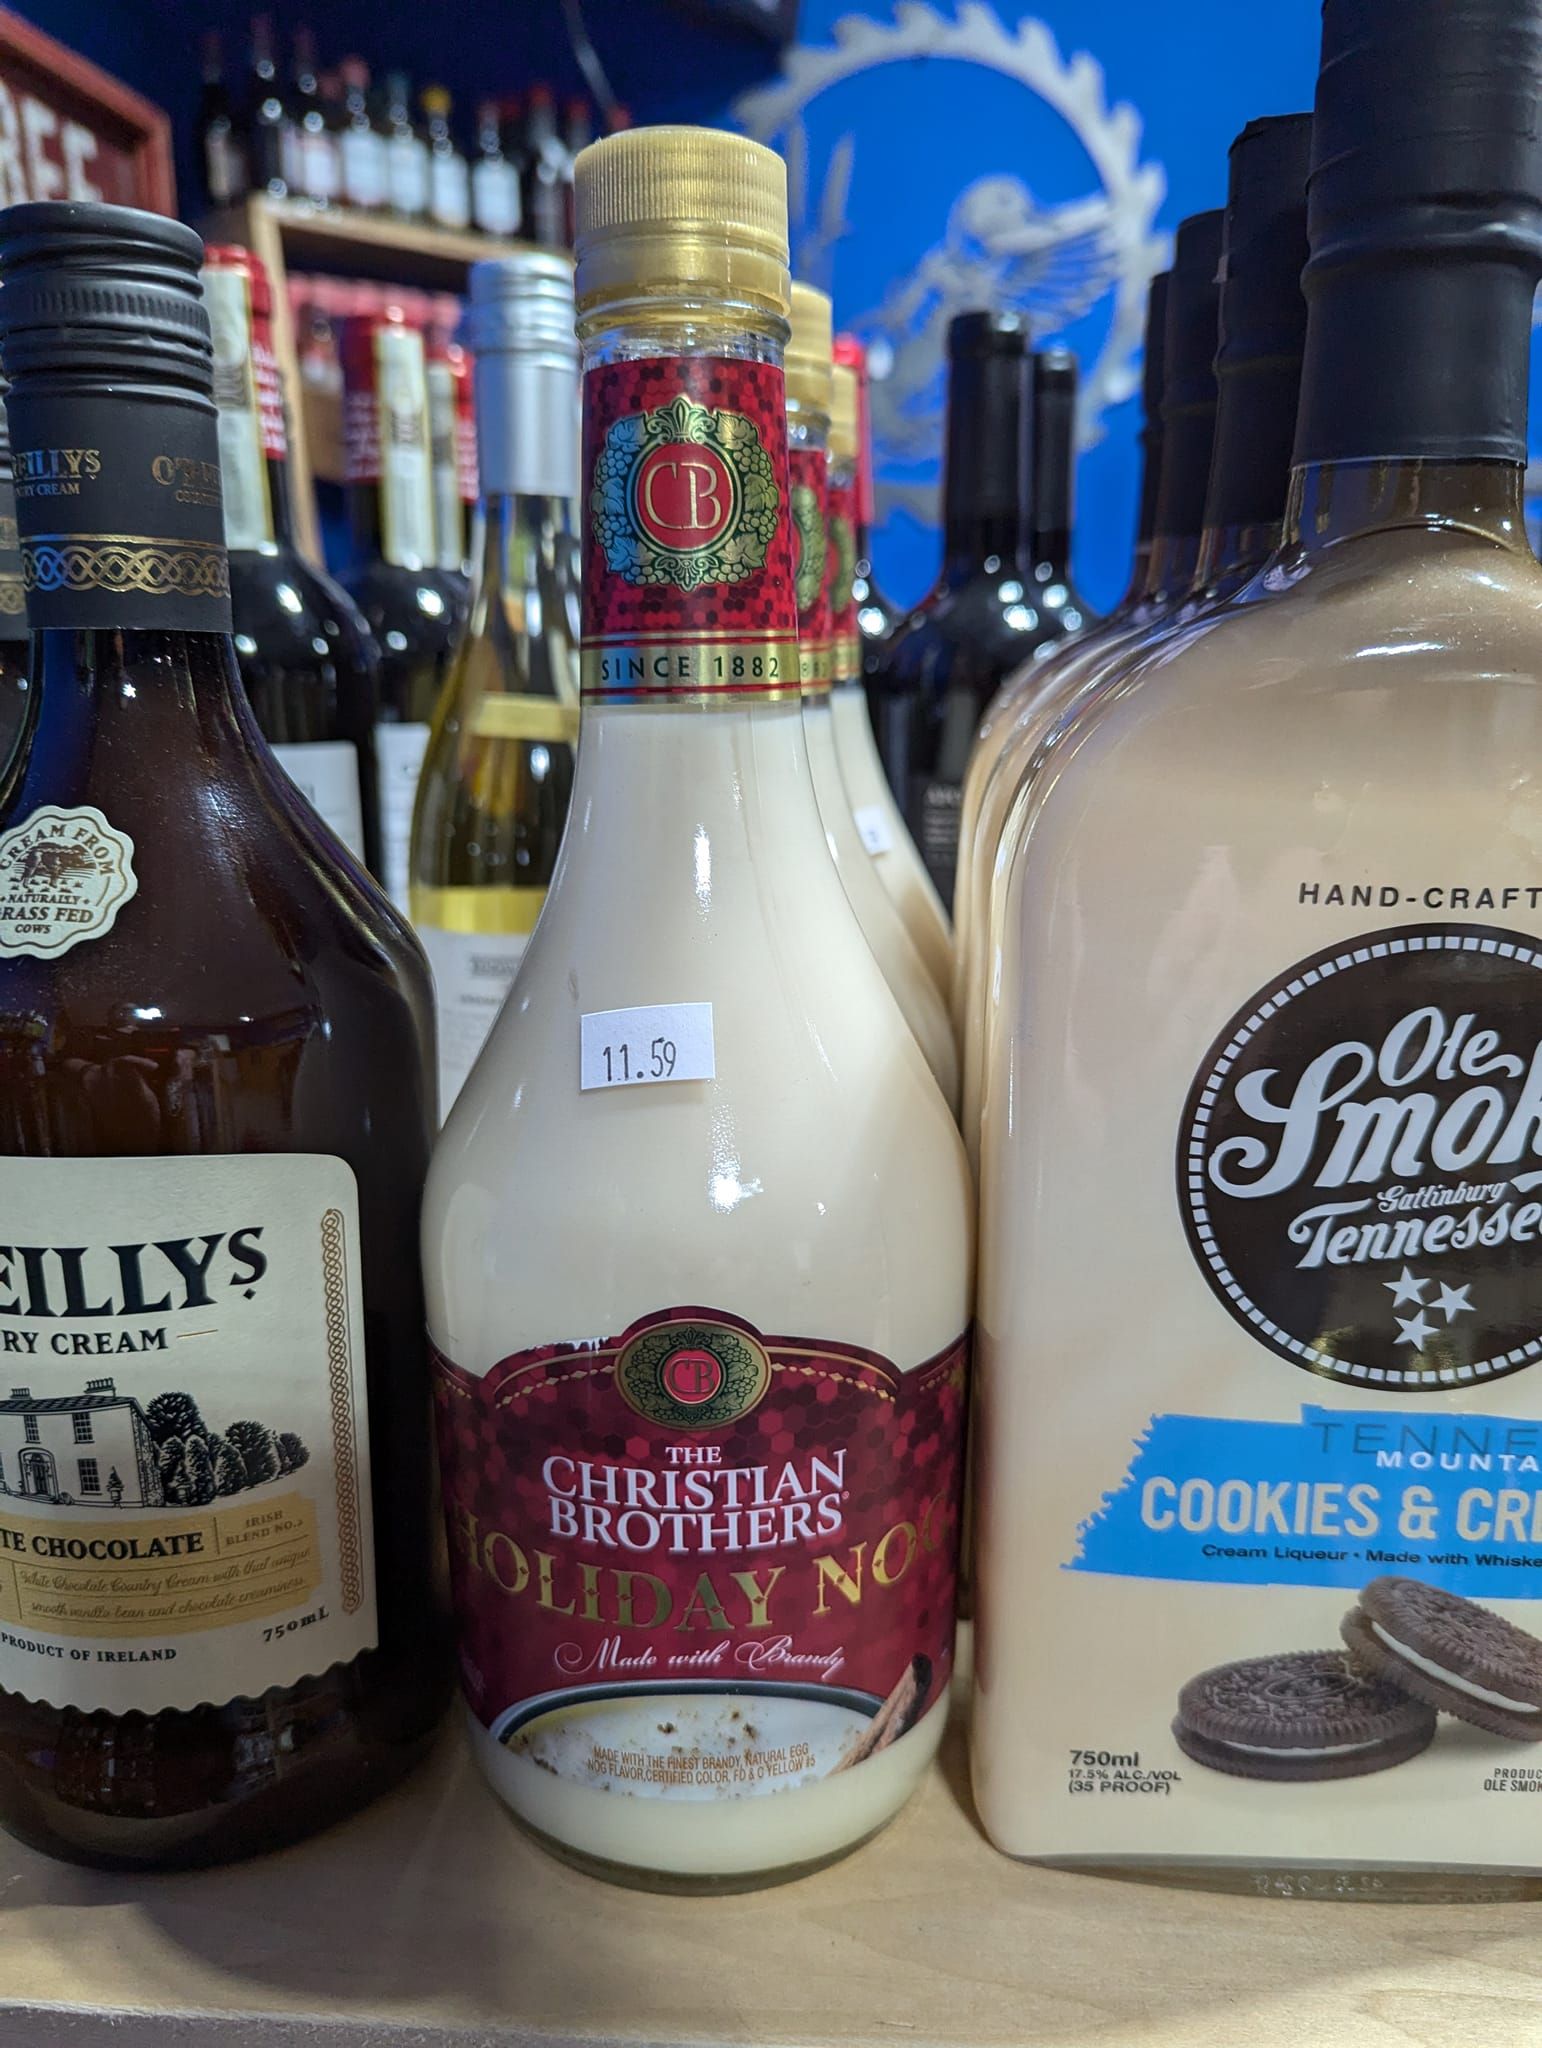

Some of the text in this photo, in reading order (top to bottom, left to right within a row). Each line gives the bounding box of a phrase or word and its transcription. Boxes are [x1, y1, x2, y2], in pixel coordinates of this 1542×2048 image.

[37, 481, 80, 495] CREAM
[644, 461, 722, 530] CB
[601, 655, 780, 681] SINCE 1882
[72, 827, 116, 875] FROM
[8, 893, 82, 905] NATURALLY
[1298, 882, 1542, 910] HAND-CRAFT
[0, 906, 94, 924] RASS FED
[15, 923, 52, 935] COWS
[602, 1036, 677, 1082] 11.59
[1378, 1006, 1525, 1088] Ole
[1377, 1181, 1510, 1213] Gatlinburg
[1287, 1199, 1542, 1269] Tennesse
[51, 1327, 169, 1355] CREAM
[669, 1357, 715, 1394] CB
[1310, 1421, 1539, 1458] TENNE
[665, 1446, 722, 1464] THE
[1375, 1449, 1540, 1472] MOUNTA
[542, 1448, 847, 1511] CHRISTIAN
[246, 1510, 283, 1529] IRISH
[548, 1491, 844, 1553] BROTHERS
[1140, 1476, 1380, 1537] COOKIES
[1399, 1485, 1438, 1540] &
[32, 1531, 204, 1560] CHOCOLATE
[226, 1529, 270, 1546] BLEND
[453, 1500, 786, 1632] HOLIDAY
[1202, 1544, 1542, 1569] Cream Liqueur Made with Whiske
[52, 1574, 109, 1593] Chocolate
[166, 1573, 209, 1590] Cream
[213, 1565, 240, 1583] with
[32, 1600, 68, 1616] smooth
[115, 1604, 145, 1619] bean
[148, 1600, 175, 1617] and
[177, 1592, 235, 1613] chocolate
[263, 1605, 330, 1642] 750mL
[1, 1631, 177, 1662] PRODUCT OF IRELAND
[554, 1634, 846, 1681] Made with Brandy
[586, 1759, 608, 1774] NOG
[733, 1766, 746, 1781] FD
[766, 1757, 804, 1777] YELLOW
[593, 1744, 619, 1761] MADE
[621, 1752, 645, 1766] WITH
[645, 1753, 665, 1769] THE
[666, 1755, 700, 1771] FINEST
[745, 1747, 786, 1766] NATURAL
[789, 1742, 810, 1756] EGG
[1069, 1749, 1140, 1767] 750ml
[1068, 1768, 1182, 1781] 17.5% ALC./VOL
[1068, 1780, 1170, 1796] (35 PROOF)
[1483, 1778, 1507, 1791] OLE
